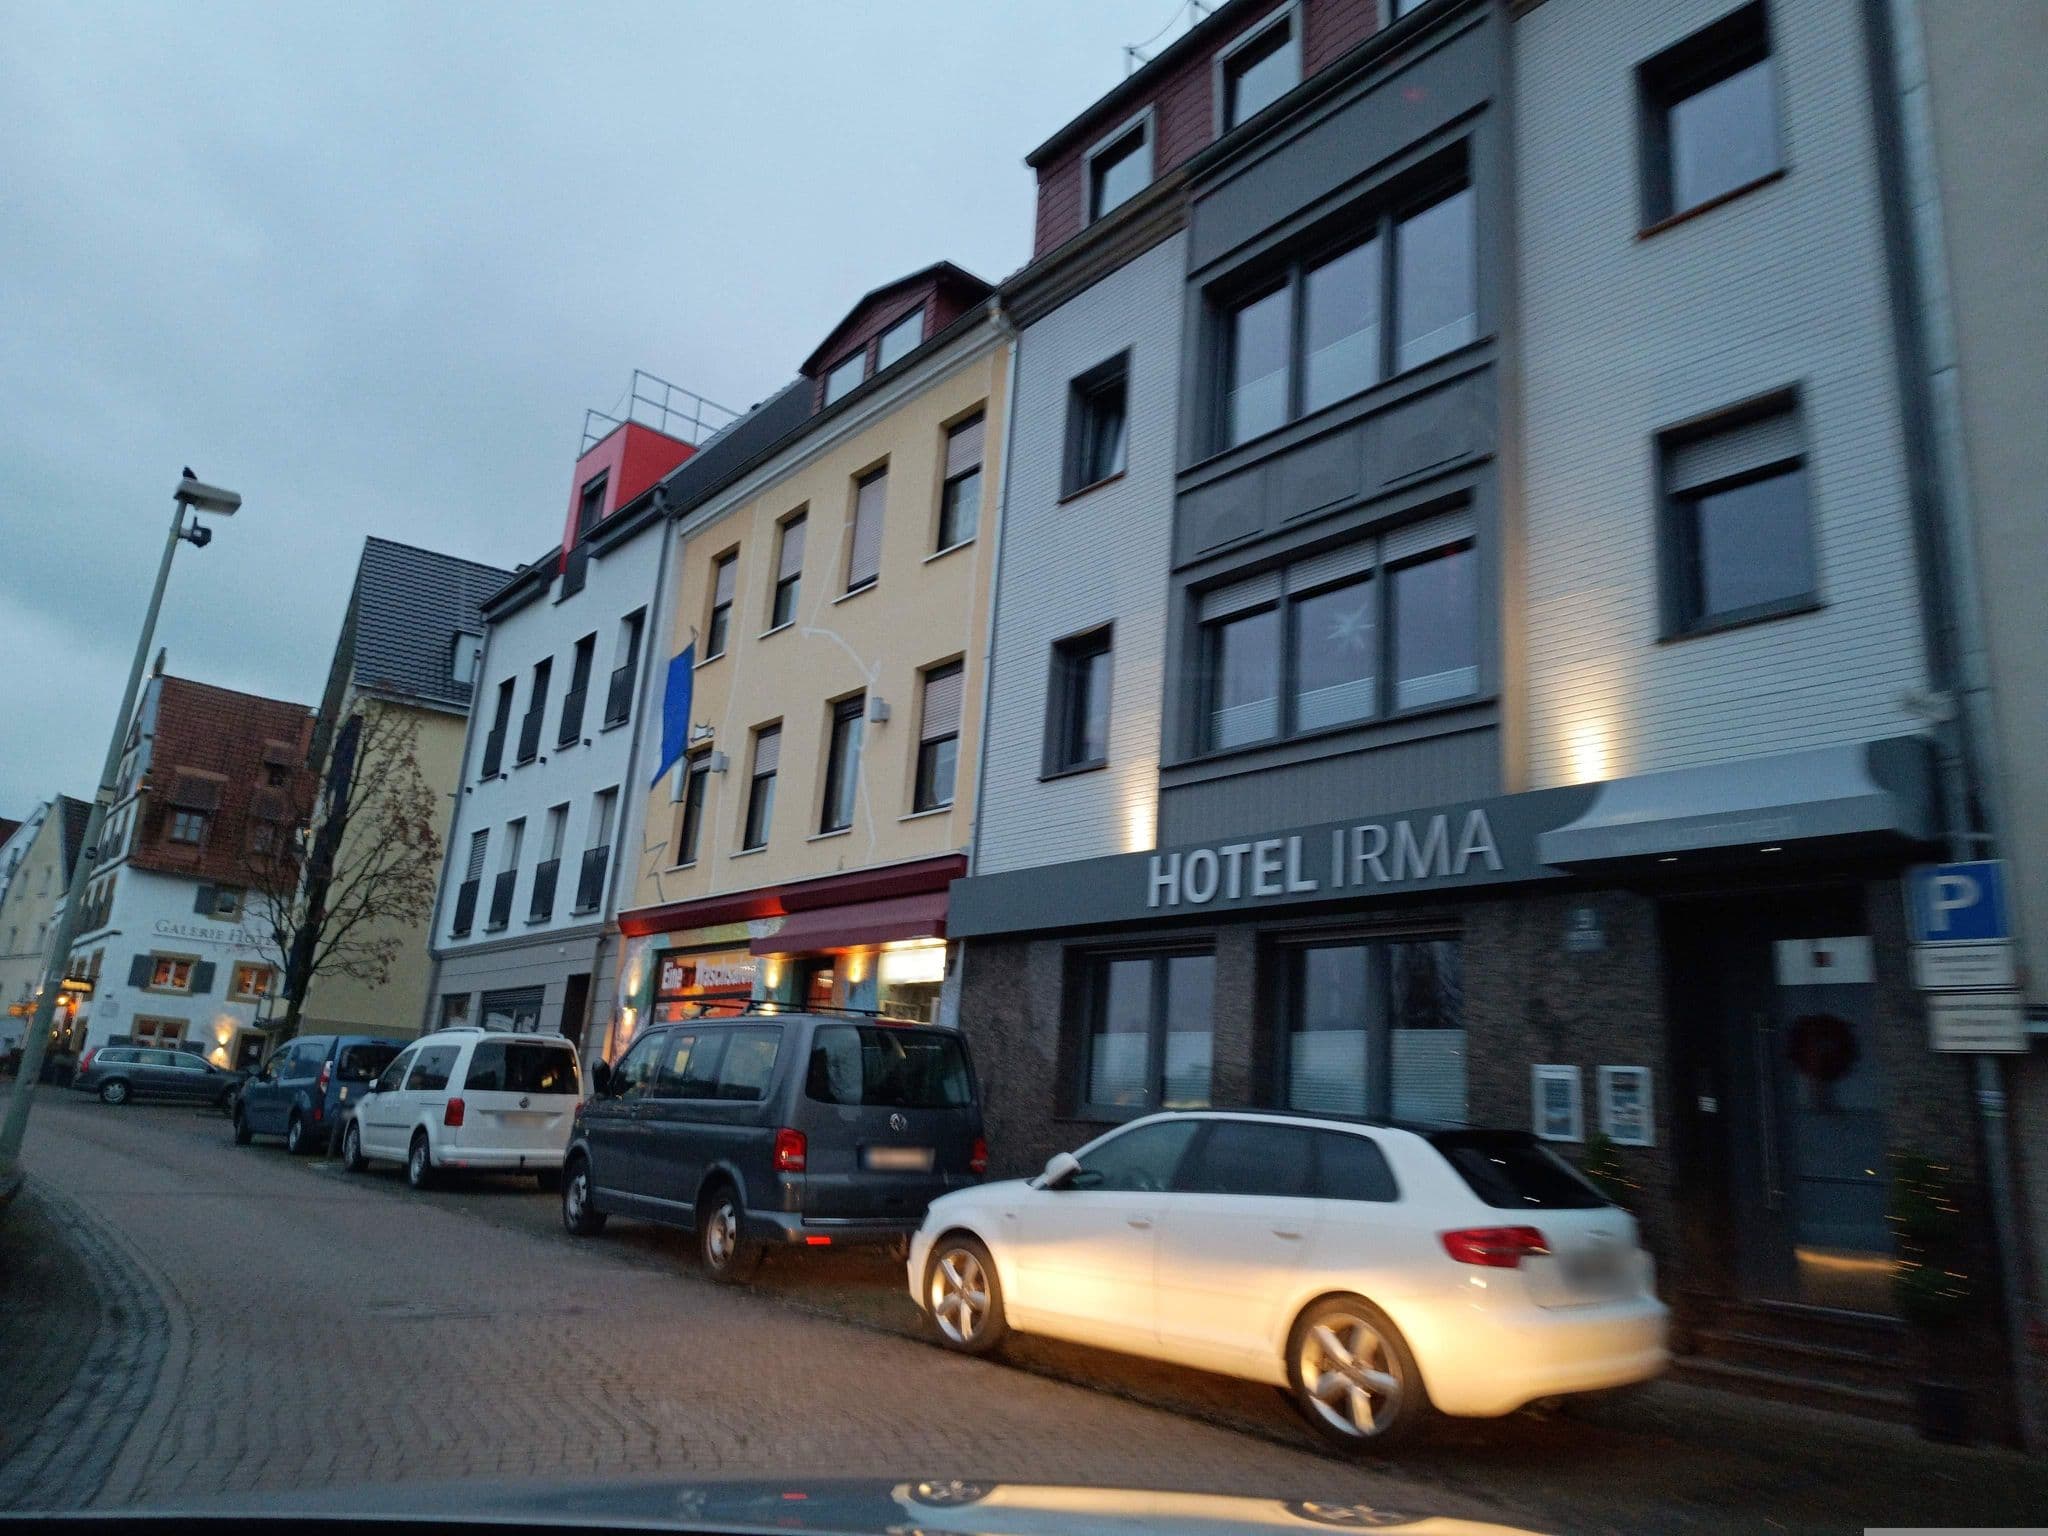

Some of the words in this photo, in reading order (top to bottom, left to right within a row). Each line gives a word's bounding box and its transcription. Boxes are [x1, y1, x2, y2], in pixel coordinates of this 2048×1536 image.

[1146, 836, 1318, 908] HOTEL
[1331, 808, 1504, 888] IRMA
[1930, 874, 1980, 932] P
